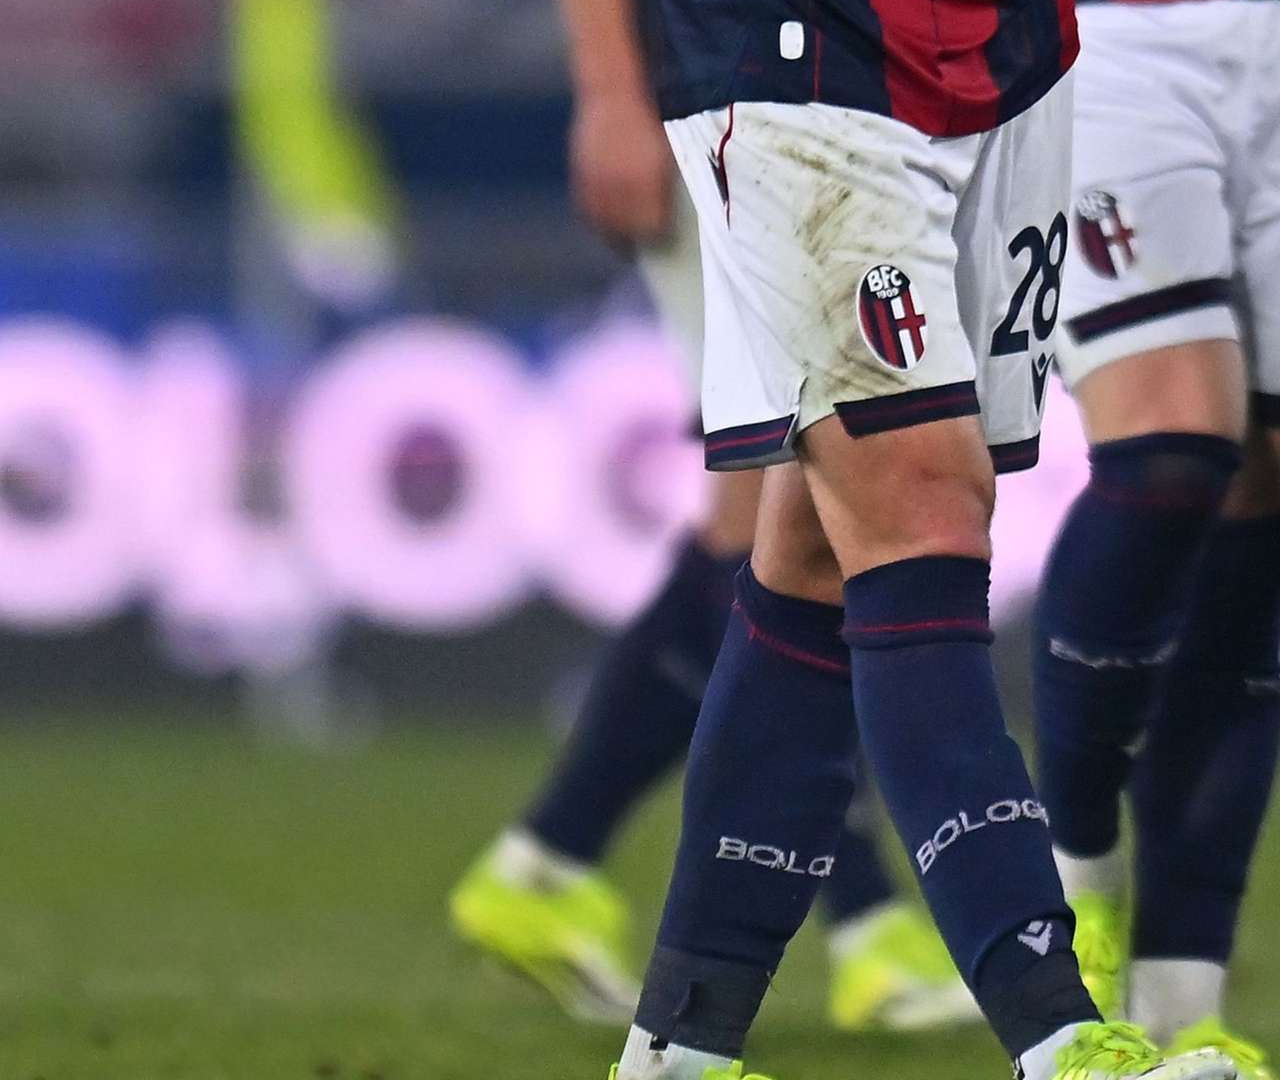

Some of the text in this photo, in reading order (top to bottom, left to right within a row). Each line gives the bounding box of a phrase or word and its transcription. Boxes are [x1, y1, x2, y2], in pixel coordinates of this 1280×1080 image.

[867, 266, 903, 292] BFC
[989, 211, 1068, 357] 28
[876, 287, 900, 300] 1909
